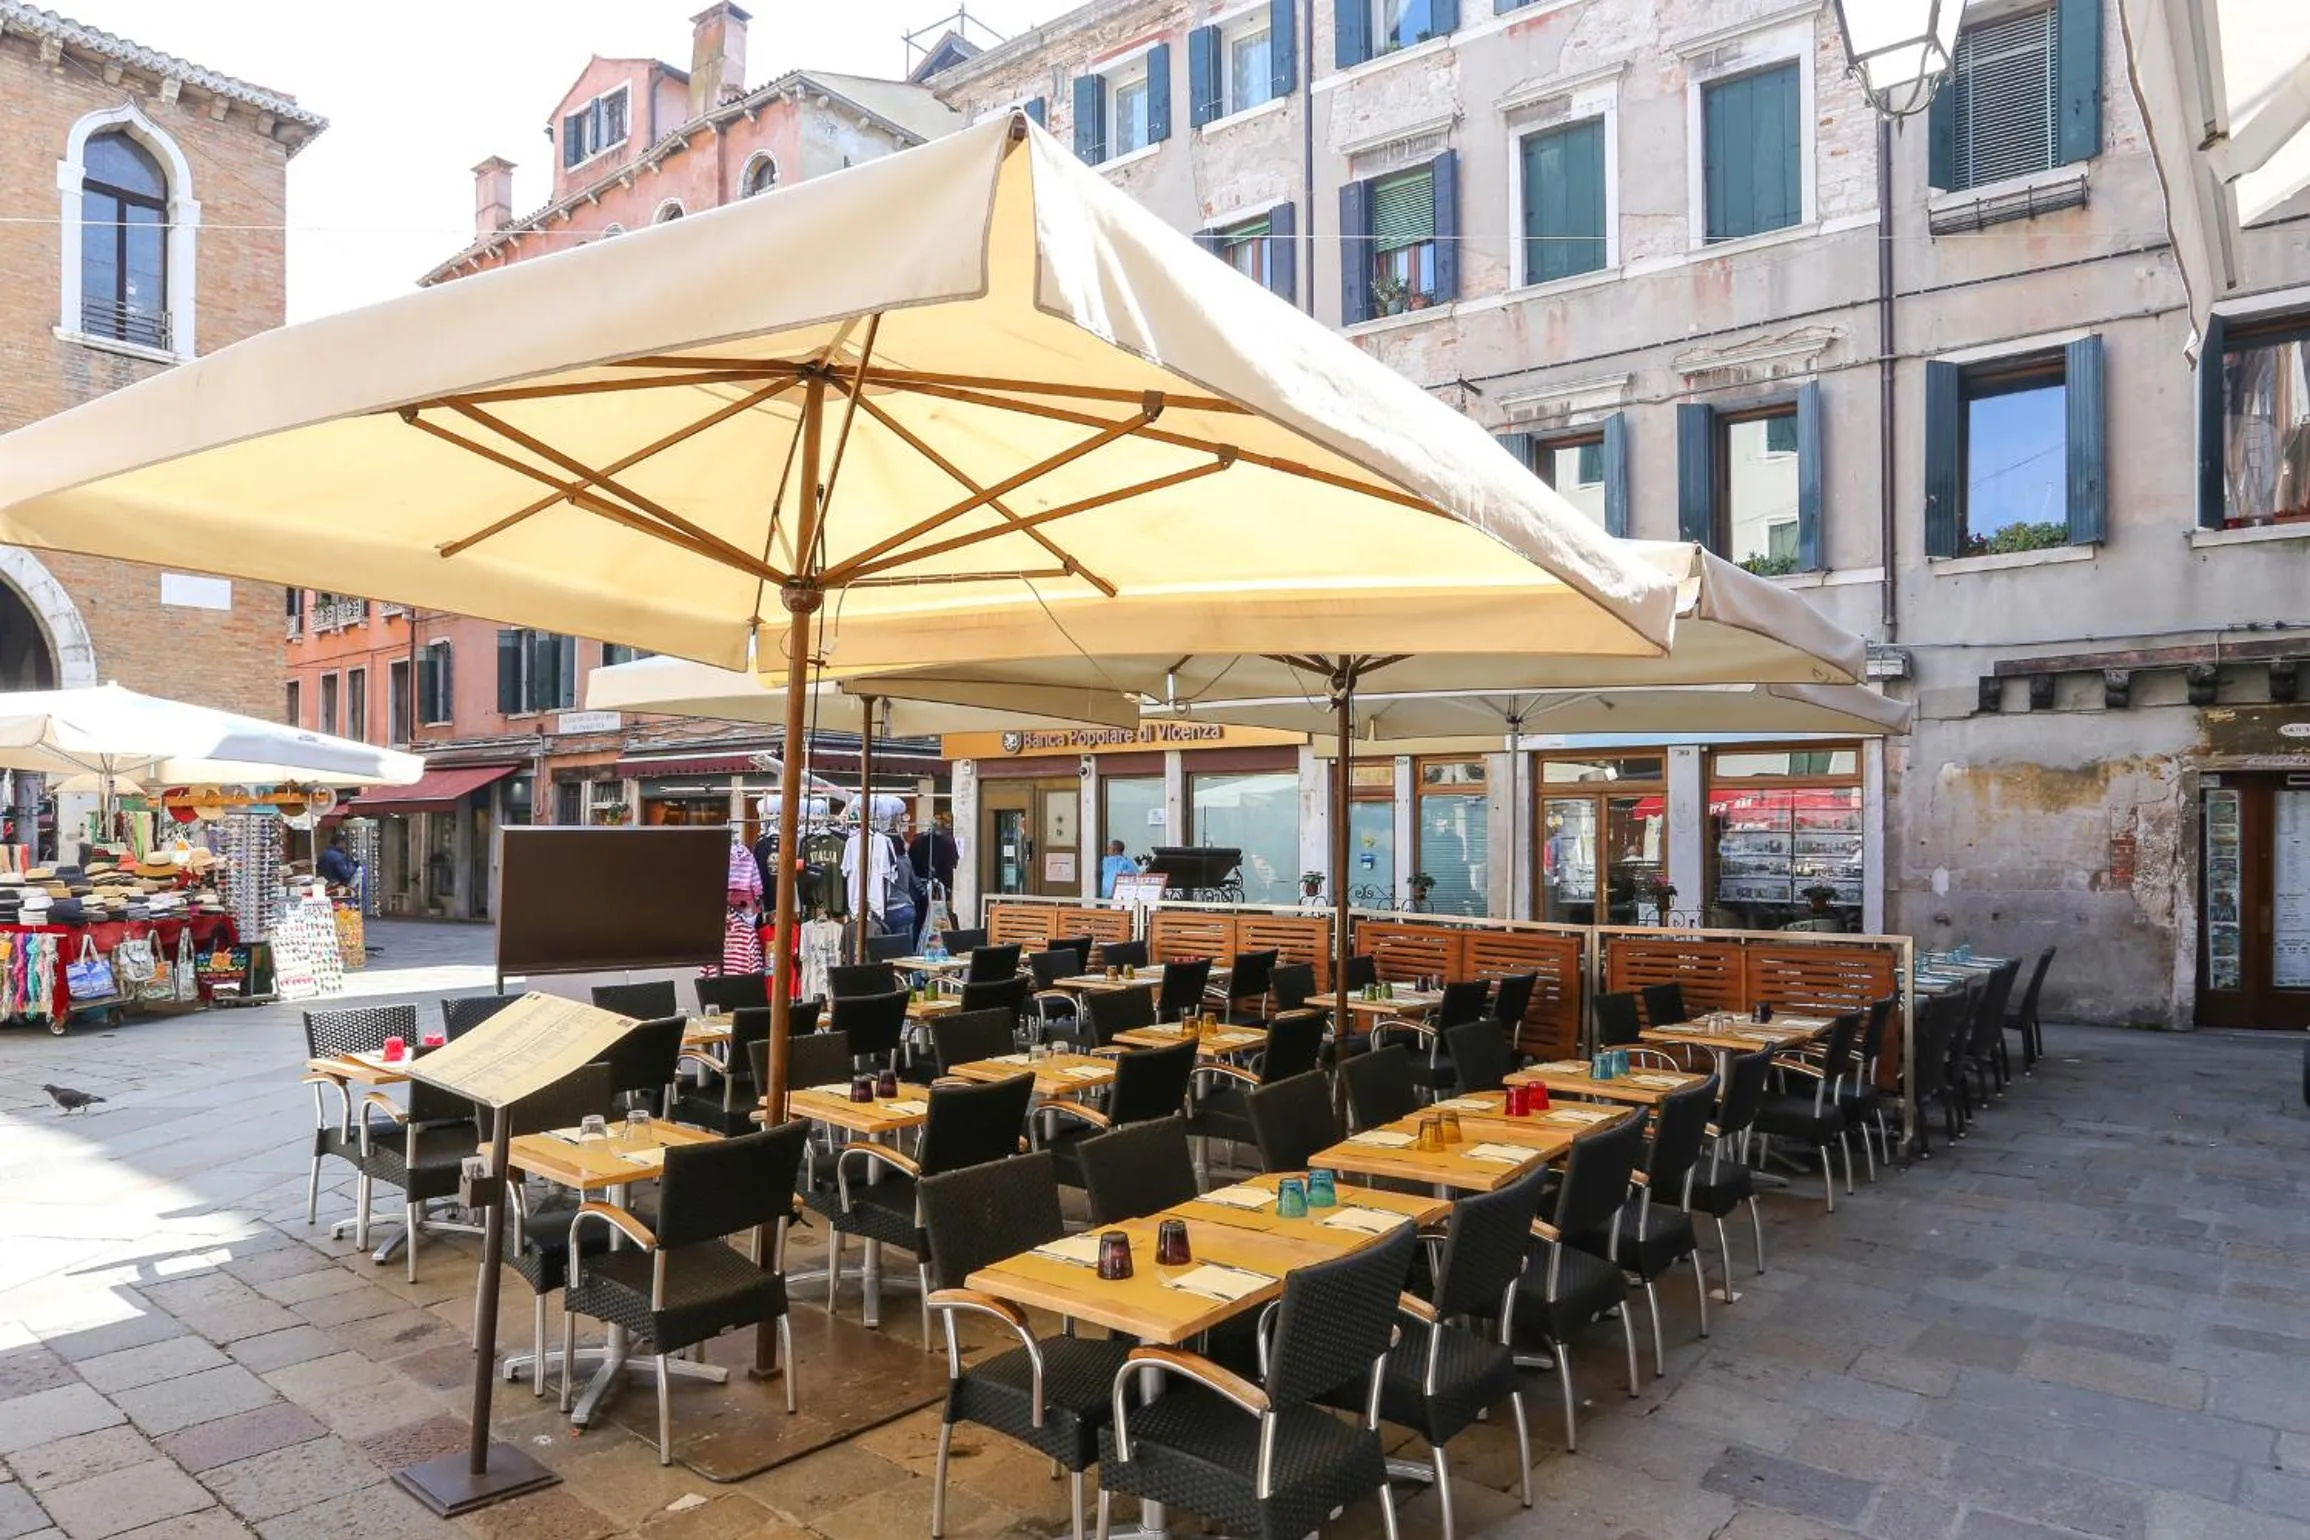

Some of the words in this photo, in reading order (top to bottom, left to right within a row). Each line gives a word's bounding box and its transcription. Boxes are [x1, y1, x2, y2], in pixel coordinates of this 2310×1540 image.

[1023, 731, 1066, 748] Banca
[1069, 728, 1135, 748] Popolare
[1137, 724, 1152, 742] di
[1157, 723, 1220, 742] Vicenza
[810, 850, 837, 863] ITALIA
